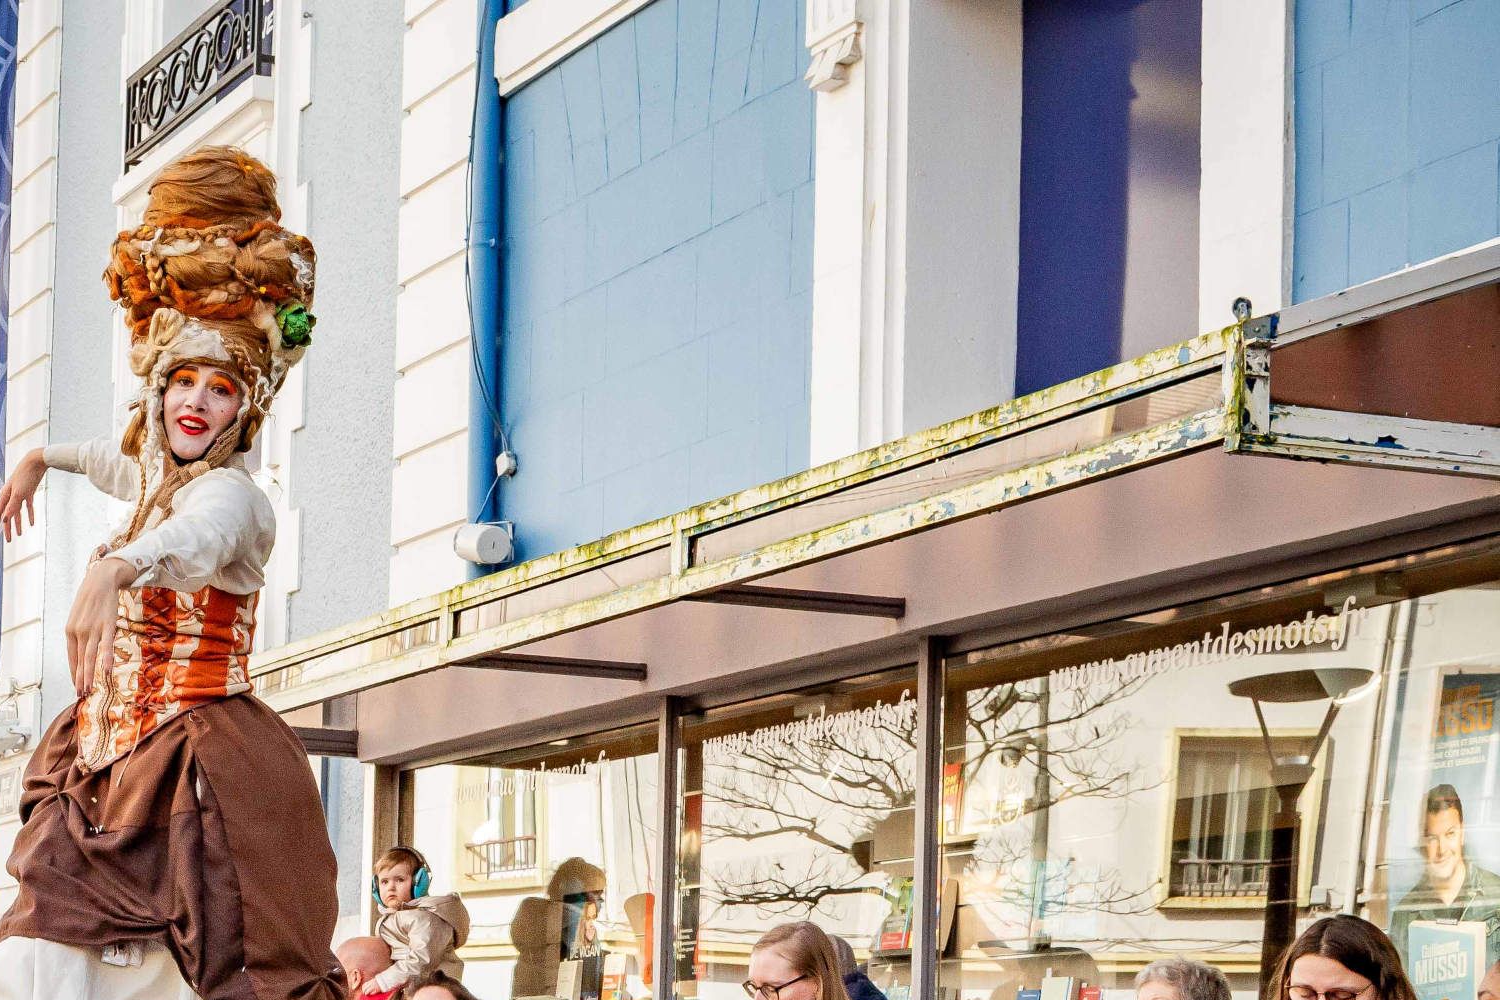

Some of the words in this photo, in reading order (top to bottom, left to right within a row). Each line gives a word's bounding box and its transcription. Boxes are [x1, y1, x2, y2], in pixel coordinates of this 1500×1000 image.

[1049, 595, 1368, 693] www.auventdesmots.fr
[1430, 698, 1493, 738] USSO
[1414, 950, 1468, 985] MUSSO
